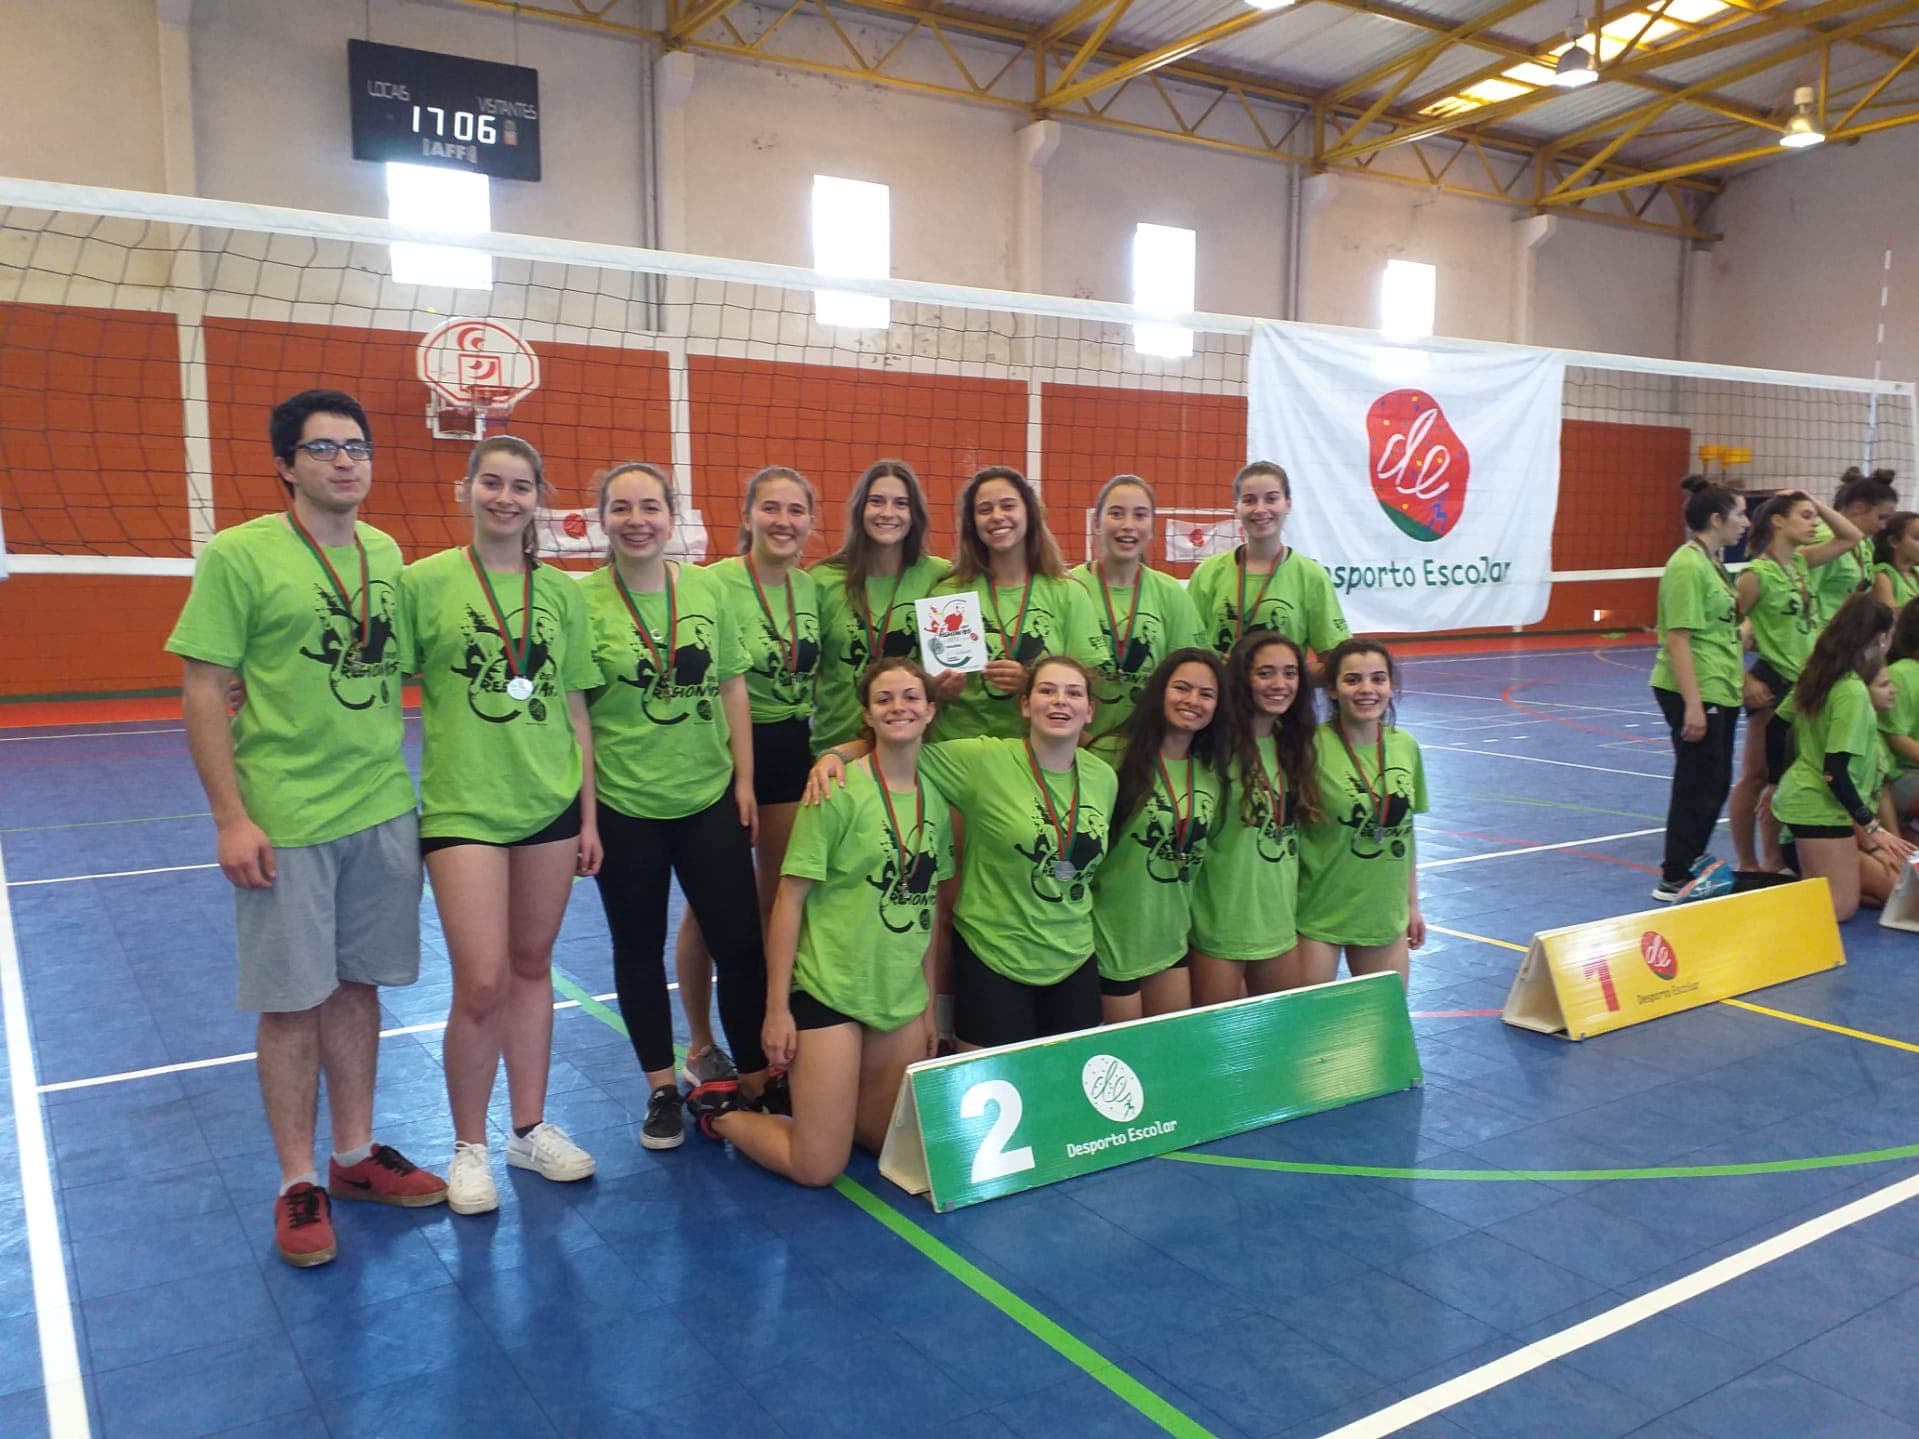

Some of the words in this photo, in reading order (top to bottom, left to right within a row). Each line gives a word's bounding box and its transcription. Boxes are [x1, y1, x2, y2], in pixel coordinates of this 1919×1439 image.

[1322, 560, 1416, 595] sporto
[1422, 555, 1512, 588] Escolar
[960, 1079, 1036, 1185] 2
[1065, 1132, 1128, 1159] Desporto
[1126, 1119, 1178, 1142] Escolar
